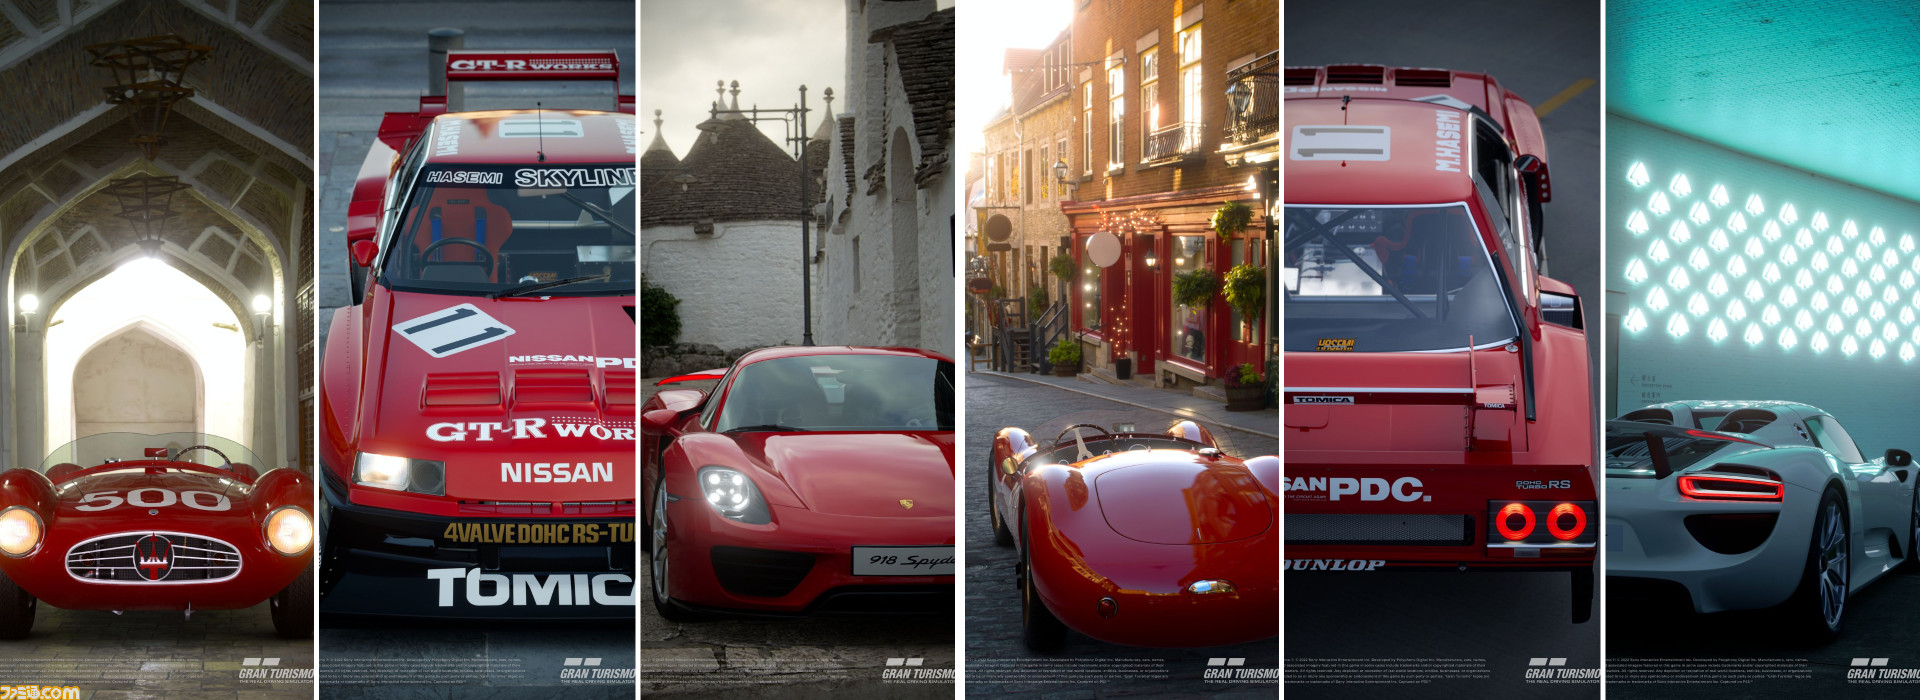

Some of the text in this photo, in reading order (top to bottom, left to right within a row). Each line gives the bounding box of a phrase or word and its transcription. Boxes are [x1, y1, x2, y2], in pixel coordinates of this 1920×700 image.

[450, 59, 527, 70] GT-R
[1297, 128, 1384, 157] 11
[1436, 110, 1461, 172] M.HASEMI
[426, 170, 503, 185] HASEMI
[403, 307, 508, 354] 11
[509, 354, 595, 363] NISSAN
[426, 418, 548, 442] GT-R
[501, 462, 614, 483] NISSAN
[1548, 480, 1571, 489] RS
[75, 488, 231, 512] 500
[444, 522, 636, 544] 4VALVE DOHC RS-TU
[870, 555, 898, 565] 918
[428, 567, 636, 607] TOMIC
